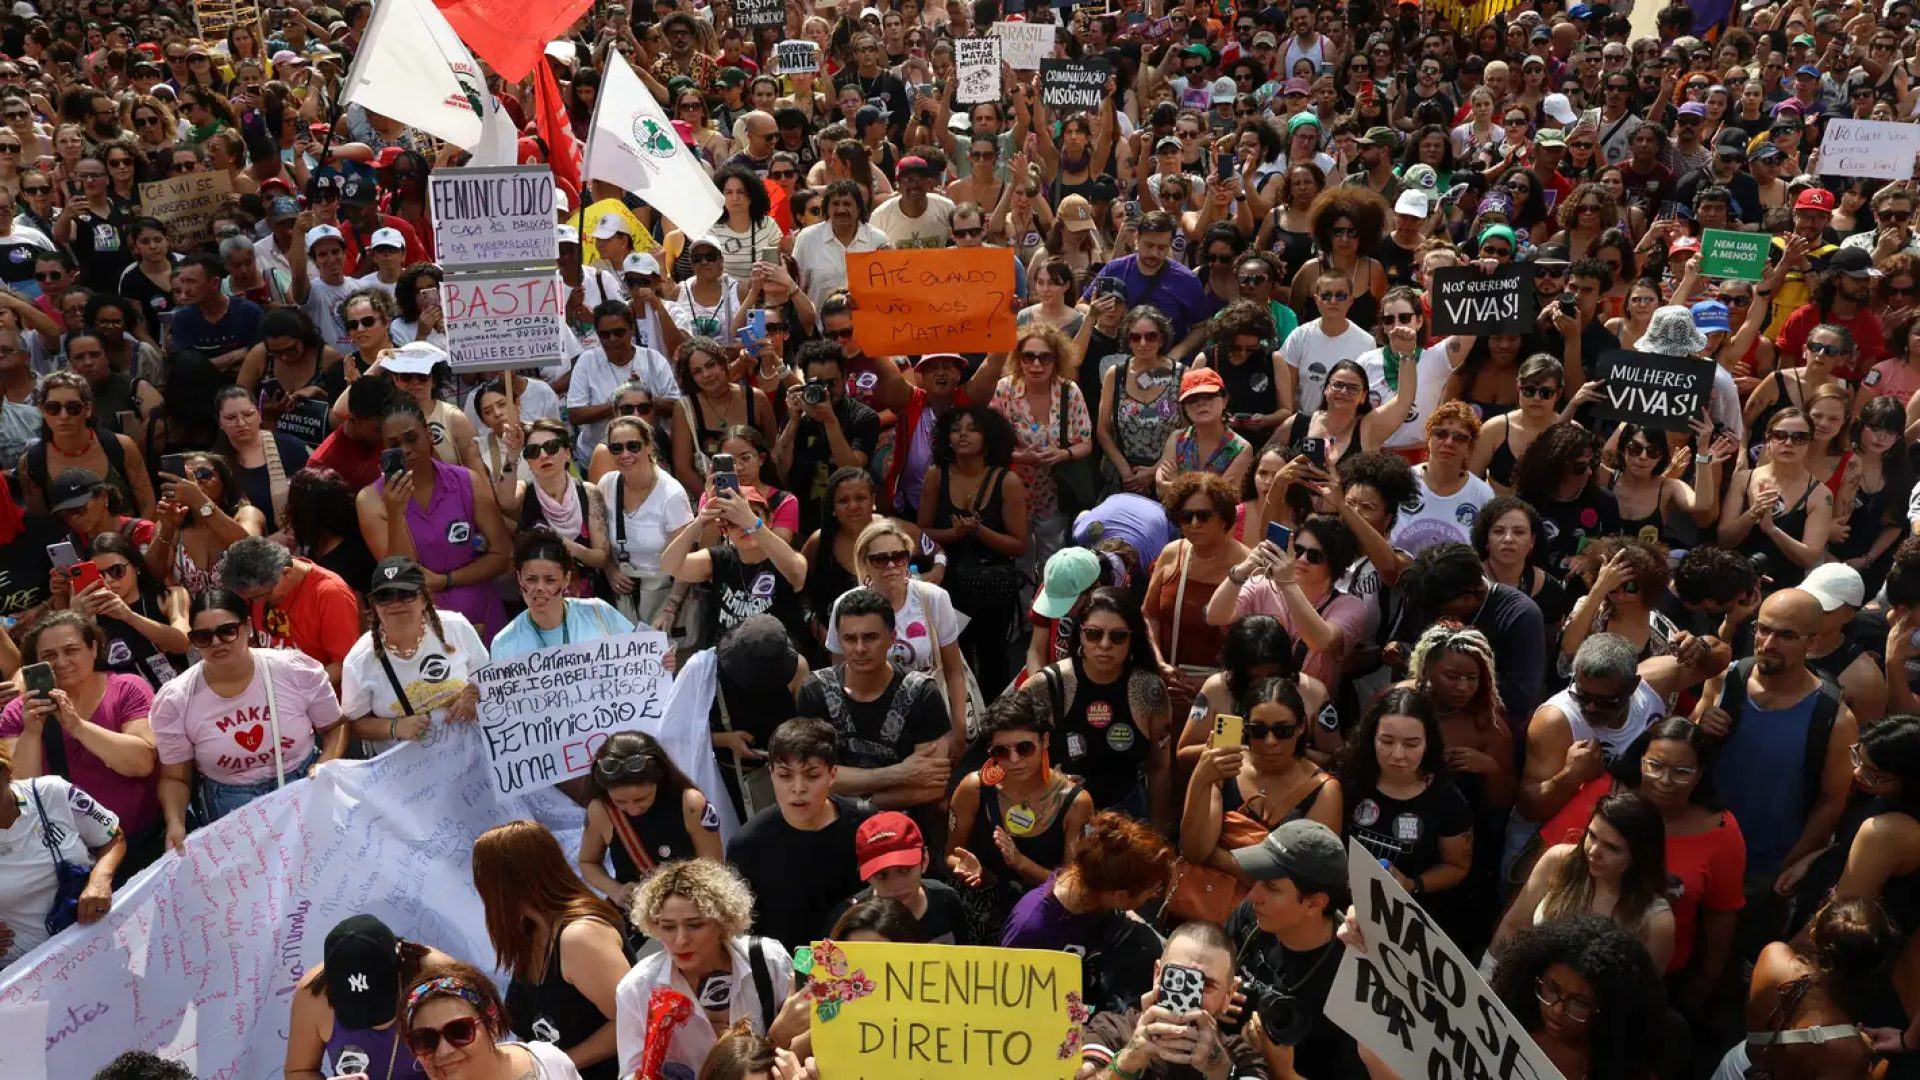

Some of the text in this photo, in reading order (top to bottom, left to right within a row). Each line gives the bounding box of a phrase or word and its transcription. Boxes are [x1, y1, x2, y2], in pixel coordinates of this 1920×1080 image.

[961, 41, 994, 51] PARE DE
[997, 25, 1049, 42] BRASIL
[961, 50, 994, 60] MATAR
[1043, 86, 1102, 106] MISOGINIA
[170, 181, 190, 195] VAI
[196, 177, 215, 191] SE
[431, 173, 553, 220] FEMINICÍDIO
[151, 195, 210, 216] ARREPENDER
[450, 224, 483, 237] CAÇA
[512, 218, 554, 231] BRUXAS
[1713, 240, 1758, 251] NEM UMA
[869, 261, 998, 288] ATÉ QUANDO
[1442, 276, 1520, 294] NOS QUEREMOS
[444, 279, 564, 320] BASTA!
[876, 298, 912, 314] VÃO
[1444, 292, 1519, 325] VIVAS!
[892, 319, 973, 341] MATAR
[450, 345, 525, 362] MULHERES
[1610, 364, 1697, 389] MULHERES
[1606, 385, 1698, 420] VIVAS!
[640, 692, 663, 718] É
[215, 705, 271, 733] MAKE
[494, 753, 558, 793] UMA
[1370, 878, 1466, 1008] NÃO
[885, 960, 1058, 1012] NENHUM
[1355, 957, 1416, 1052] POR
[858, 1017, 1033, 1066] DIREITO
